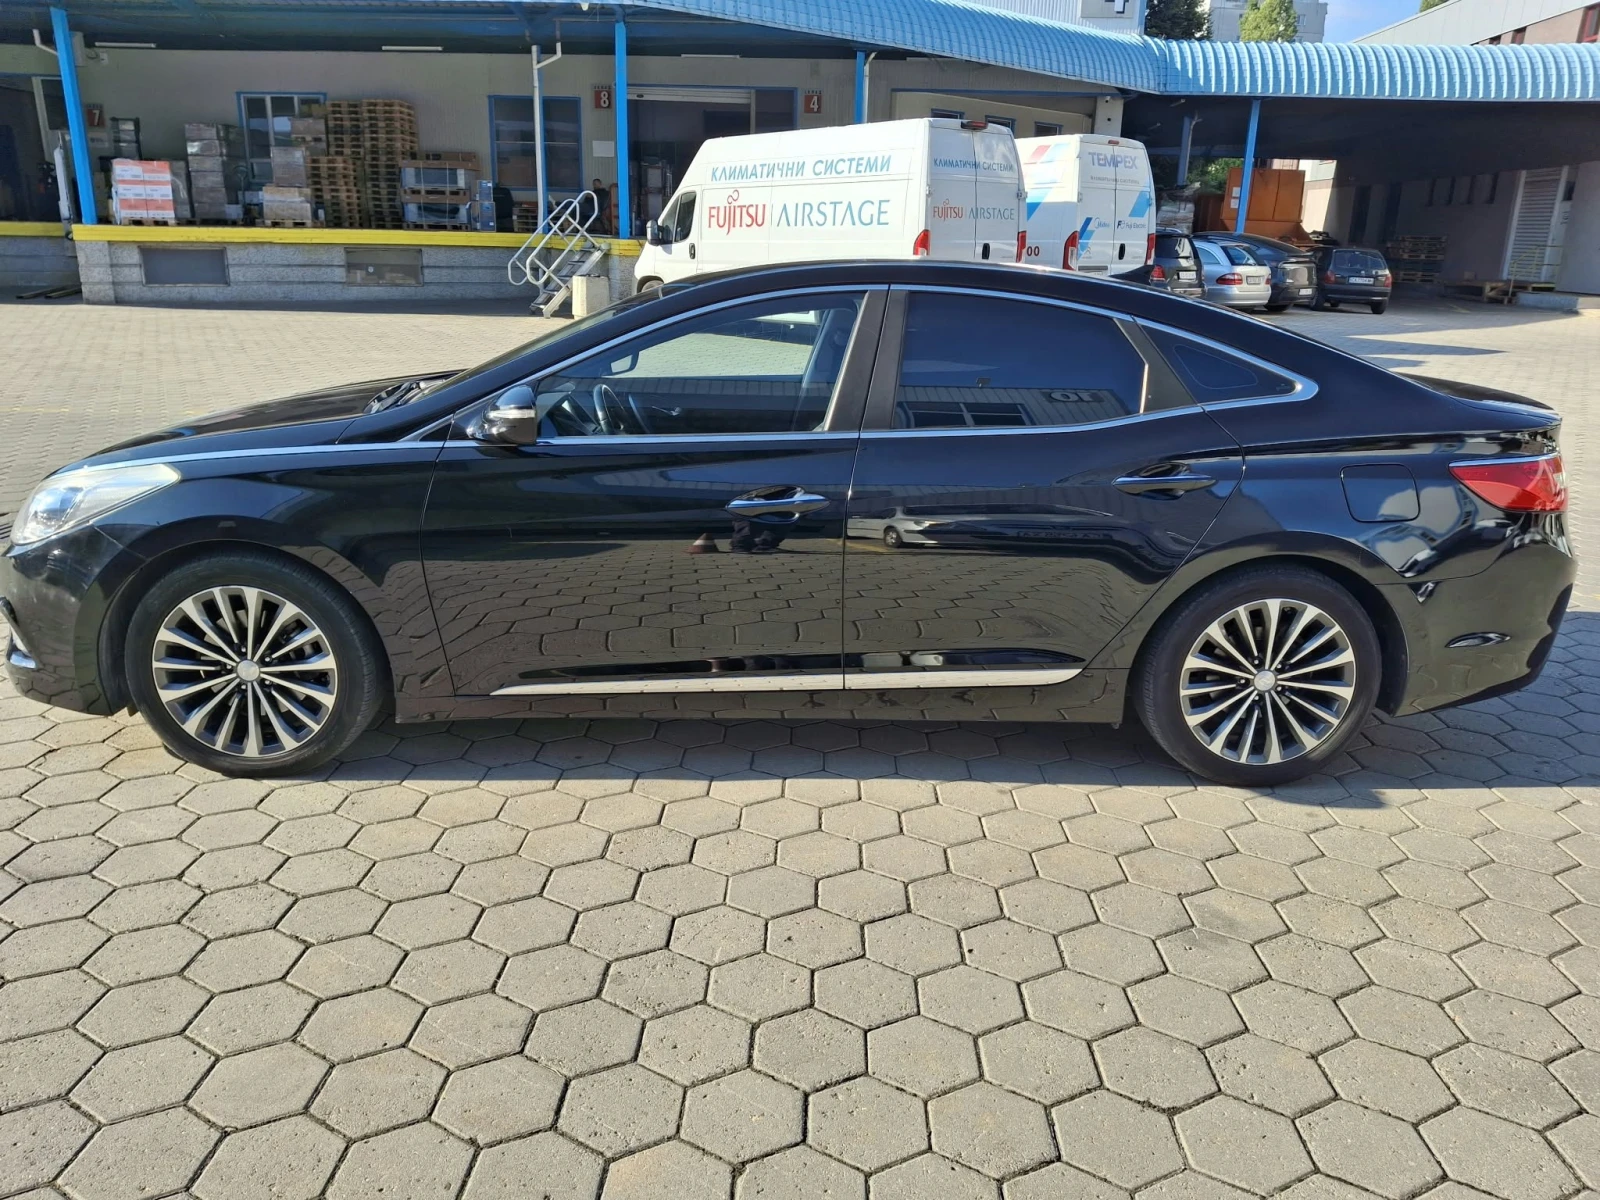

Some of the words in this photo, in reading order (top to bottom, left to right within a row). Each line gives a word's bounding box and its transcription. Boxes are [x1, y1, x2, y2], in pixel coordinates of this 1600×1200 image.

[600, 91, 609, 107] 8
[810, 95, 819, 112] 4
[92, 109, 100, 126] 7
[710, 160, 806, 182] КЛИМАТИЧНИ
[812, 154, 892, 177] СИСТЕМИ
[933, 157, 981, 171] КЛИМАТИЧНИ
[982, 161, 1014, 173] СИСТЕМИ
[1088, 152, 1138, 170] TEMPEX
[707, 190, 767, 235] FUJITSU
[776, 199, 891, 228] AIRSTAGE
[932, 199, 964, 221] FUJITSU
[968, 207, 1015, 221] AIRSTAGE
[1026, 245, 1040, 257] 00
